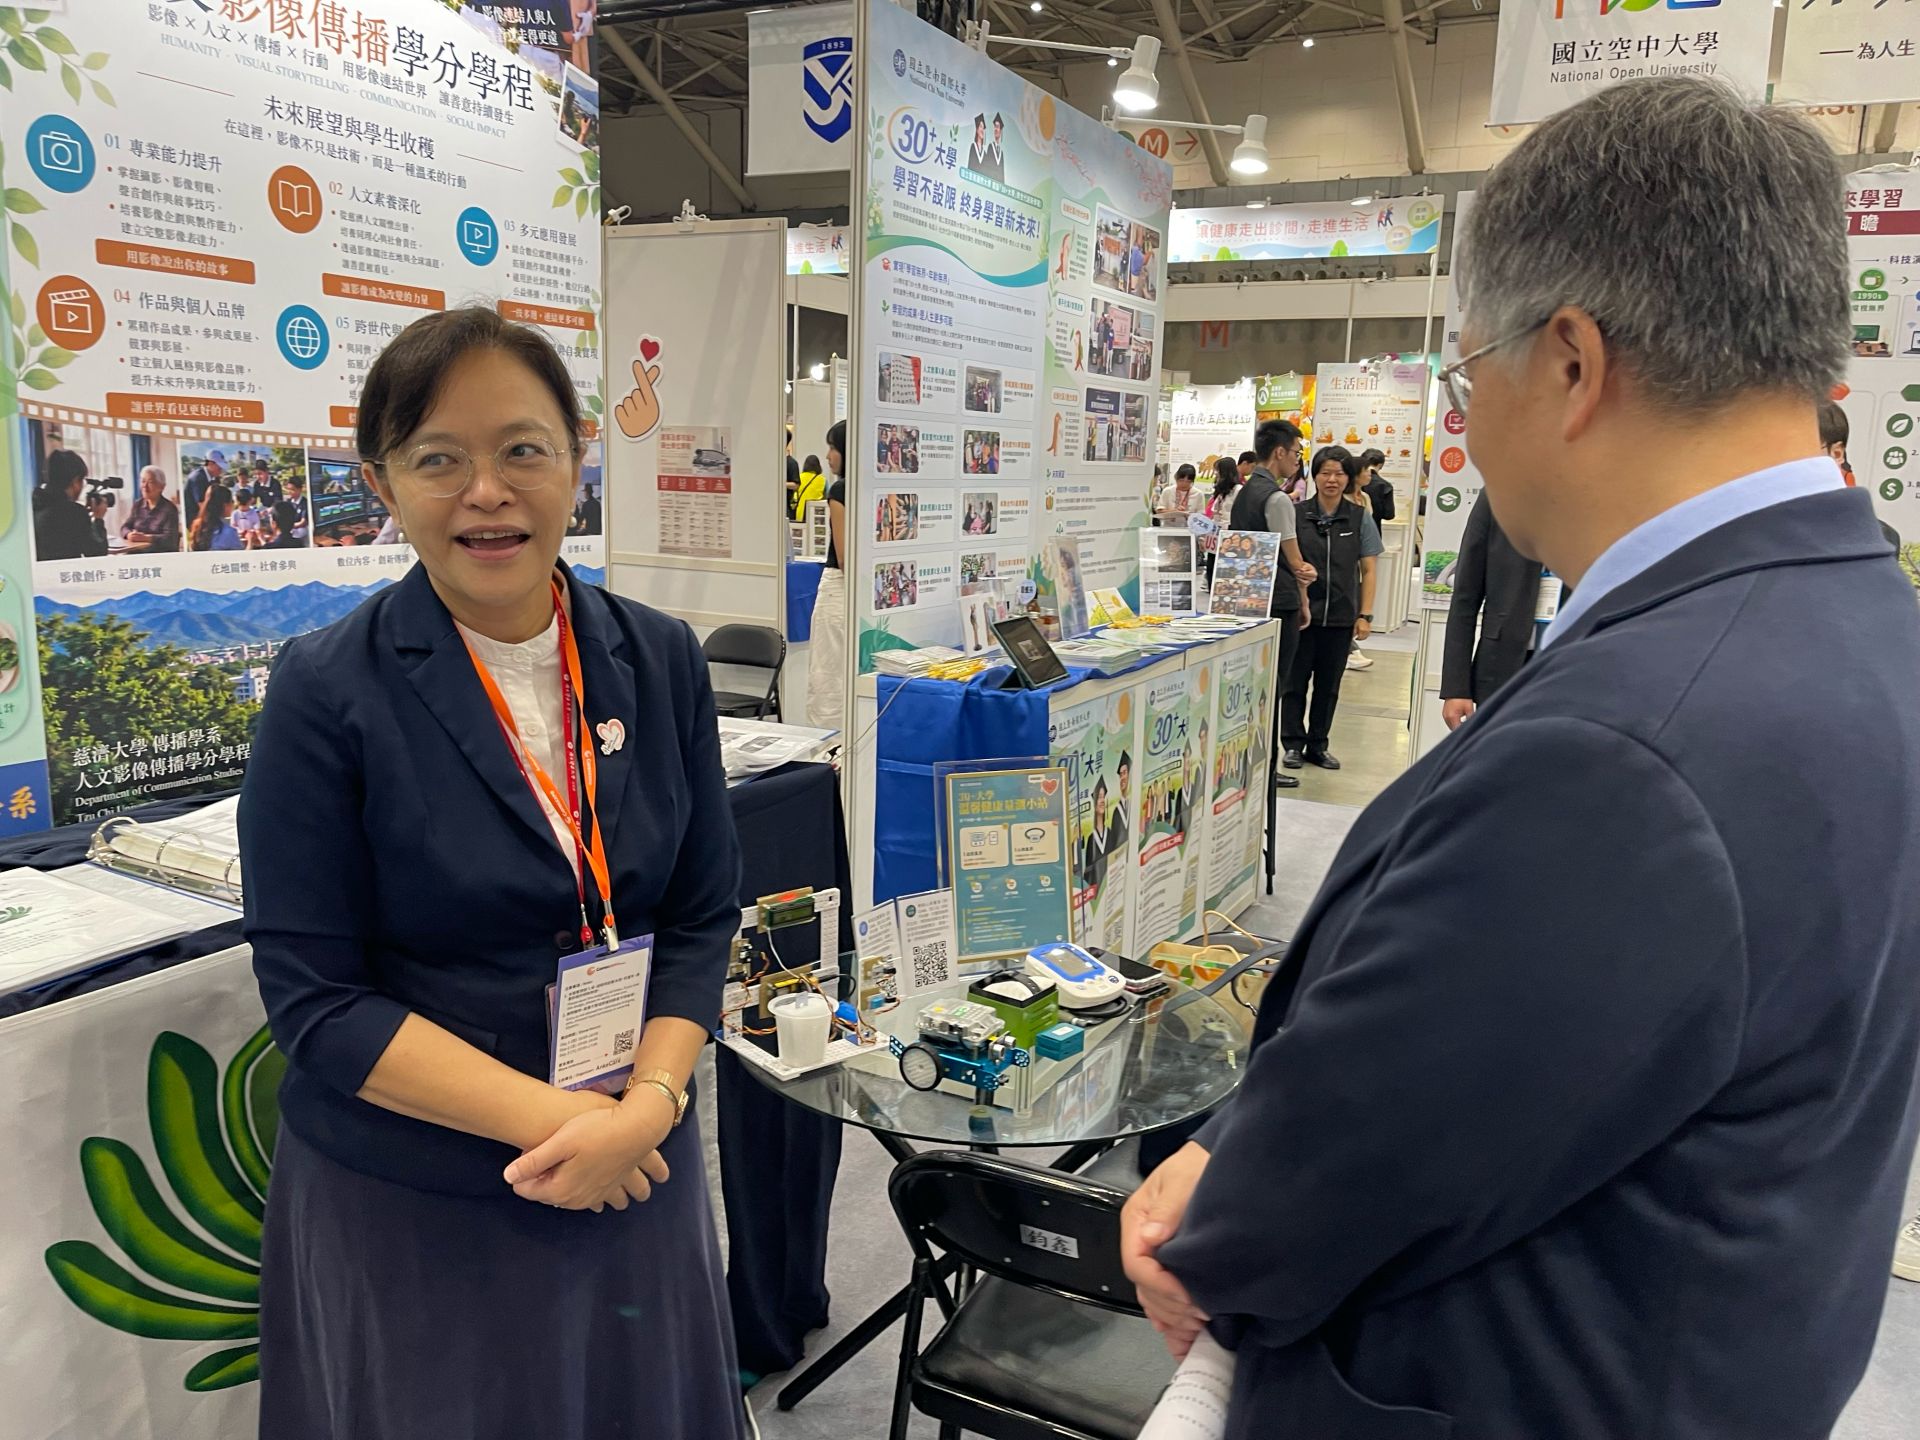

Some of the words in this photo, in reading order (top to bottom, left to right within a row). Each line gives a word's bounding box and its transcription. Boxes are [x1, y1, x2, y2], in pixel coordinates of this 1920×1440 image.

[148, 4, 179, 27] 影像
[203, 20, 232, 43] 人文
[254, 34, 281, 57] 傳播
[303, 48, 329, 71] 行動
[343, 60, 427, 99] 用影像連結世界
[165, 0, 536, 112] 影像傳播學分學程
[822, 41, 845, 50] 1895
[1551, 31, 1719, 66] 國立空中大學
[161, 33, 221, 59] HUMANITY
[235, 53, 272, 73] VISUAL
[275, 66, 349, 94] STORYTELLING
[360, 90, 437, 118] COMMUNICATION
[447, 115, 475, 131] SOCIAL
[477, 123, 506, 139] IMPACT
[1550, 68, 1604, 84] National
[1609, 65, 1644, 83] Open
[1650, 61, 1718, 77] University
[264, 95, 435, 160] 未來展望與學生收穫
[1144, 135, 1163, 149] M
[104, 133, 121, 149] 01
[129, 139, 222, 173] 專業能力提升
[935, 140, 957, 170] 大學
[329, 181, 343, 195] 02
[349, 186, 422, 215] 人文素養深化
[892, 165, 957, 212] 學習不設限
[520, 224, 577, 247] 多元應用發展
[113, 289, 130, 304] 04
[139, 292, 245, 320] 作品與個人品牌
[355, 320, 406, 337] 跨世代與
[131, 401, 244, 418] 讓世界看見更好的自己
[73, 736, 148, 767] 慈濟大學
[153, 726, 222, 753] 傳播學系
[75, 743, 251, 792] 人文影像傳播學分學程
[8, 785, 37, 819] 系
[75, 790, 130, 808] Department
[132, 784, 143, 796] of
[143, 773, 213, 793] Communication
[213, 767, 245, 780] Studies
[77, 811, 95, 824] Tzu
